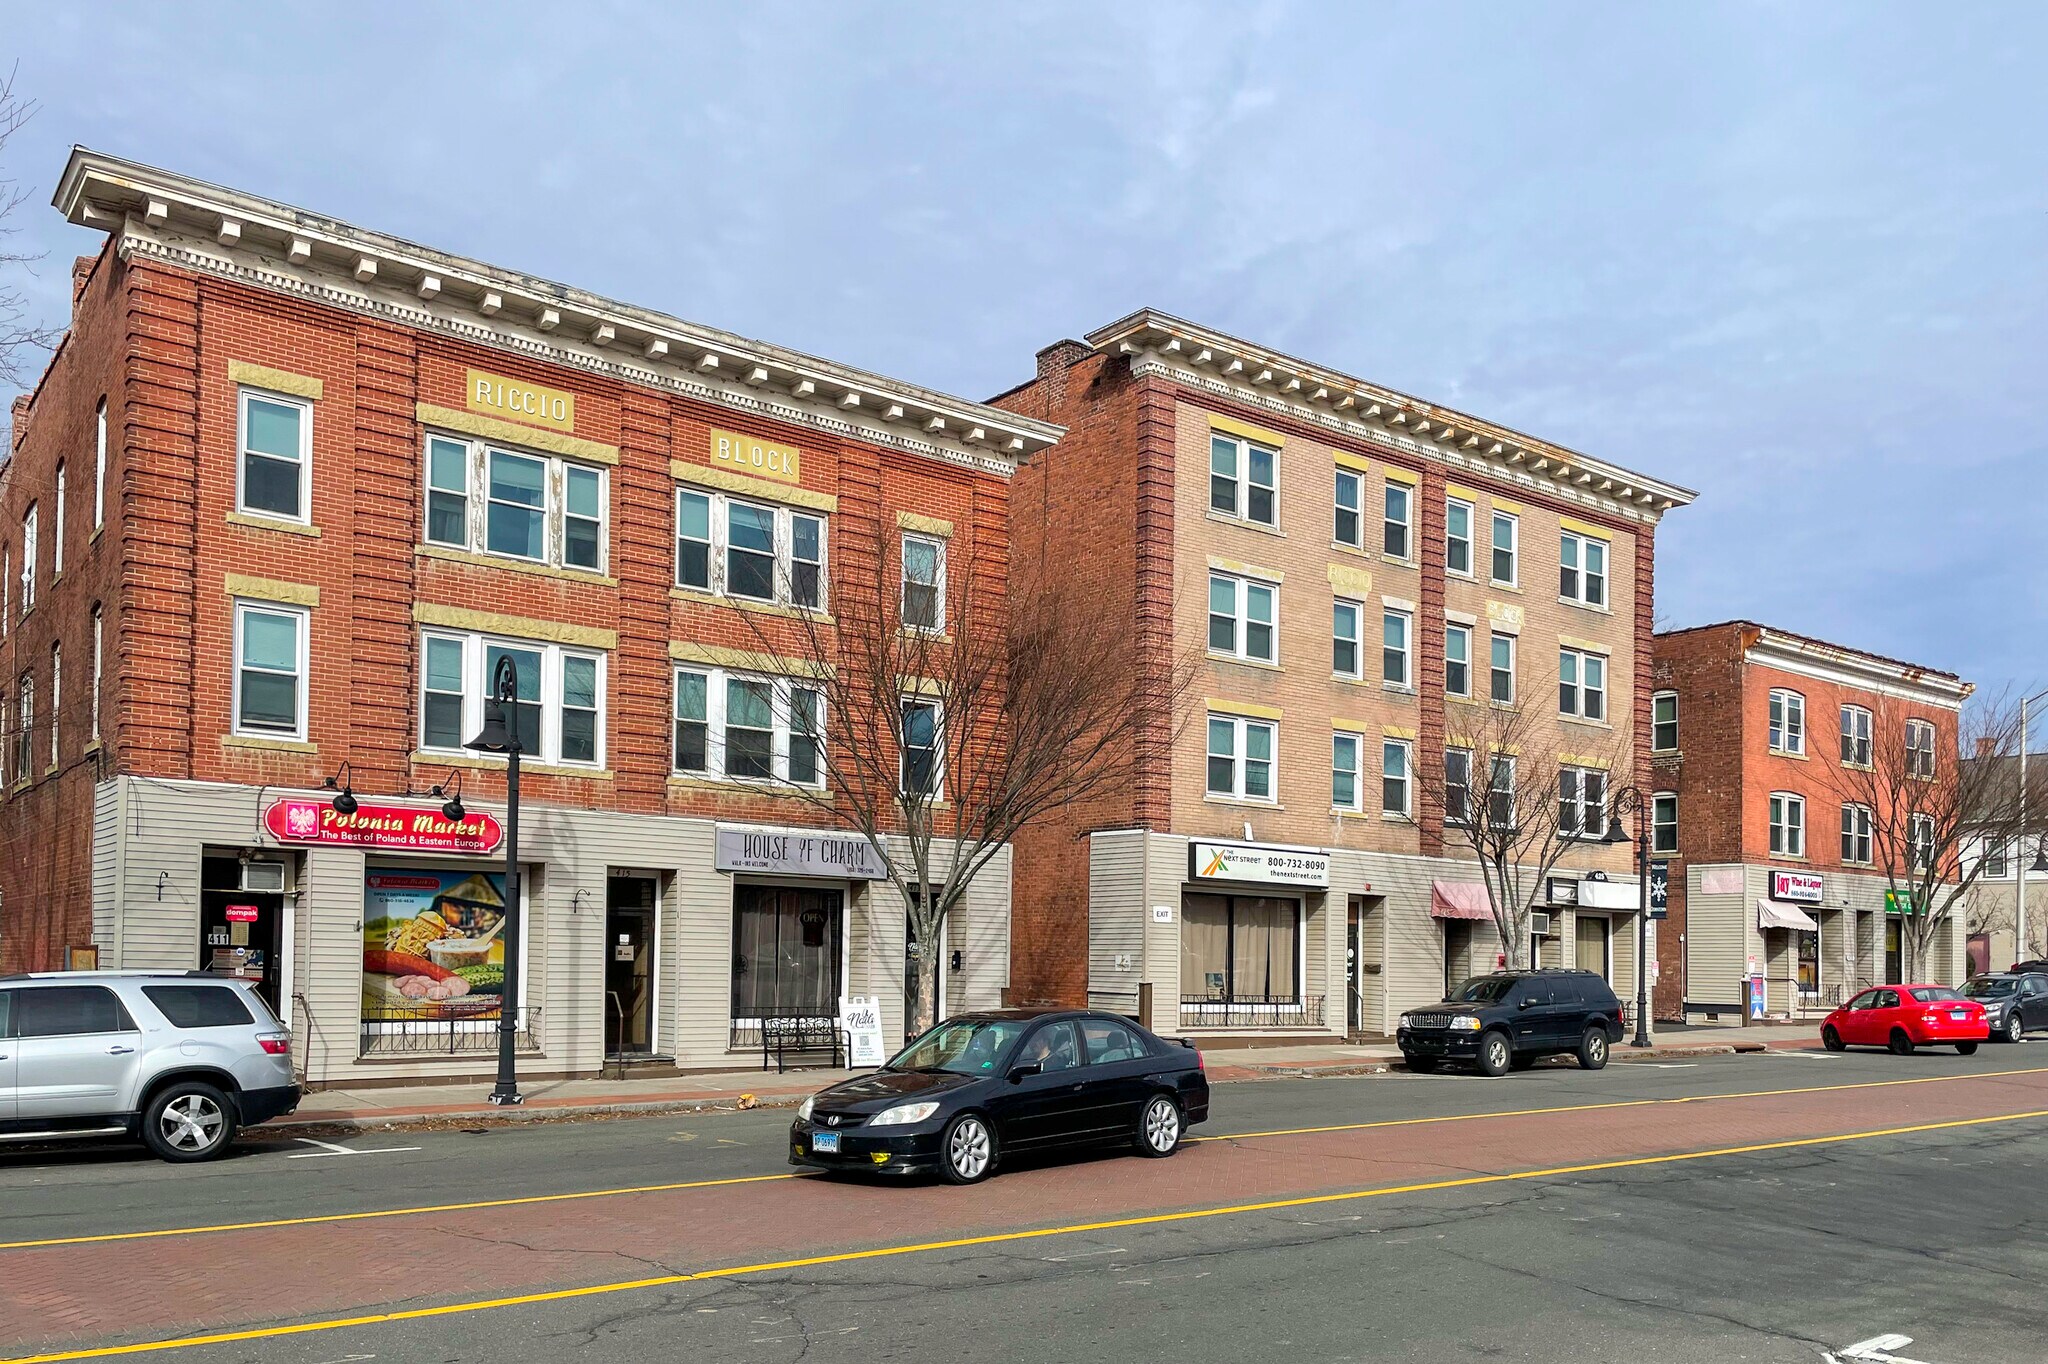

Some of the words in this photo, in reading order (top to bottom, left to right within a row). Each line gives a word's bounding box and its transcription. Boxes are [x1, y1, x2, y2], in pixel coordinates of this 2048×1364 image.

[475, 378, 566, 422] RICCIO
[717, 437, 795, 476] BLOCK
[321, 808, 403, 832] Polonia
[412, 814, 486, 836] Market
[320, 829, 339, 840] The
[341, 831, 362, 841] Best
[363, 832, 374, 842] of
[376, 833, 407, 844] Poland
[408, 835, 417, 844] &
[418, 836, 452, 847] Eastern
[454, 838, 486, 850] Europe
[743, 834, 789, 861] HOUSE
[821, 839, 866, 868] CHARM
[1267, 856, 1326, 871] 800-732-8090
[1270, 869, 1323, 881] thenextstreet.com
[1776, 874, 1790, 895] Jay
[226, 909, 258, 917] dompak
[1156, 910, 1169, 918] EXIT
[208, 934, 228, 945] 411
